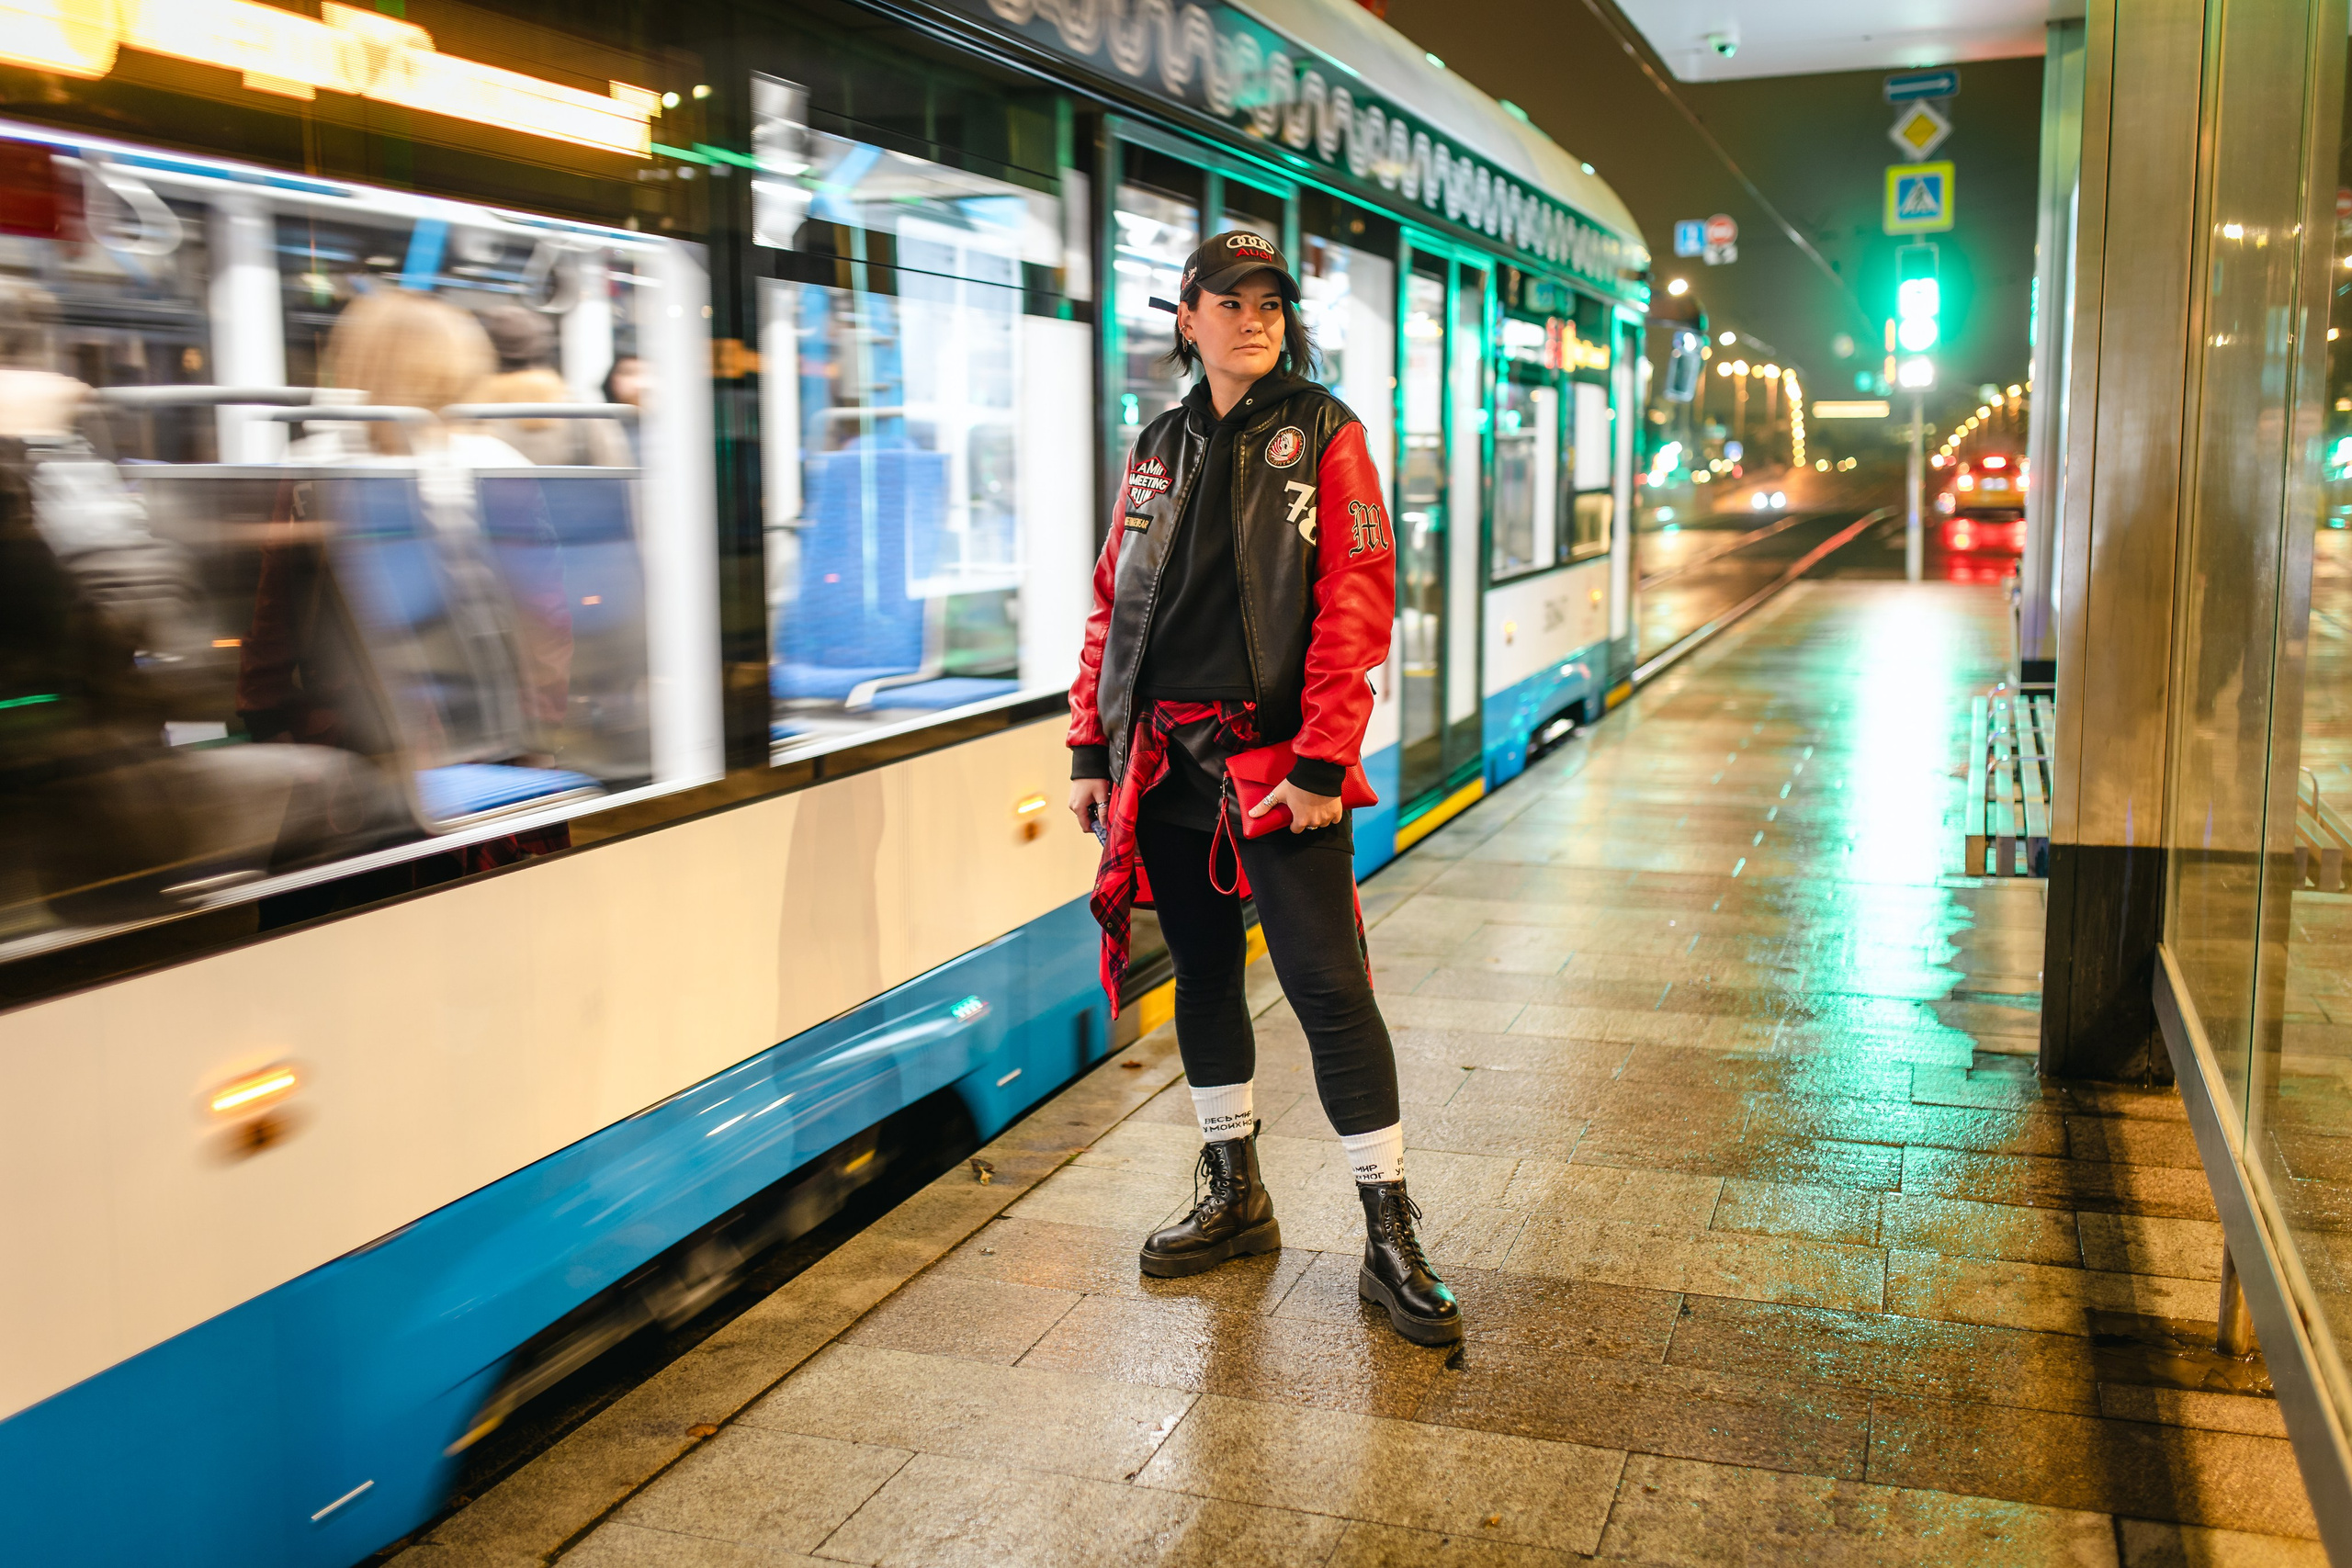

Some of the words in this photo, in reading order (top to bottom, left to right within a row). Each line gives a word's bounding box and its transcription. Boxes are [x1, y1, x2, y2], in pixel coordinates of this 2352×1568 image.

[1204, 1115, 1233, 1124] ВЕСЬ
[1209, 1121, 1242, 1133] МОИХ
[1355, 1164, 1378, 1173] МИР
[1363, 1171, 1385, 1180] НОГ
